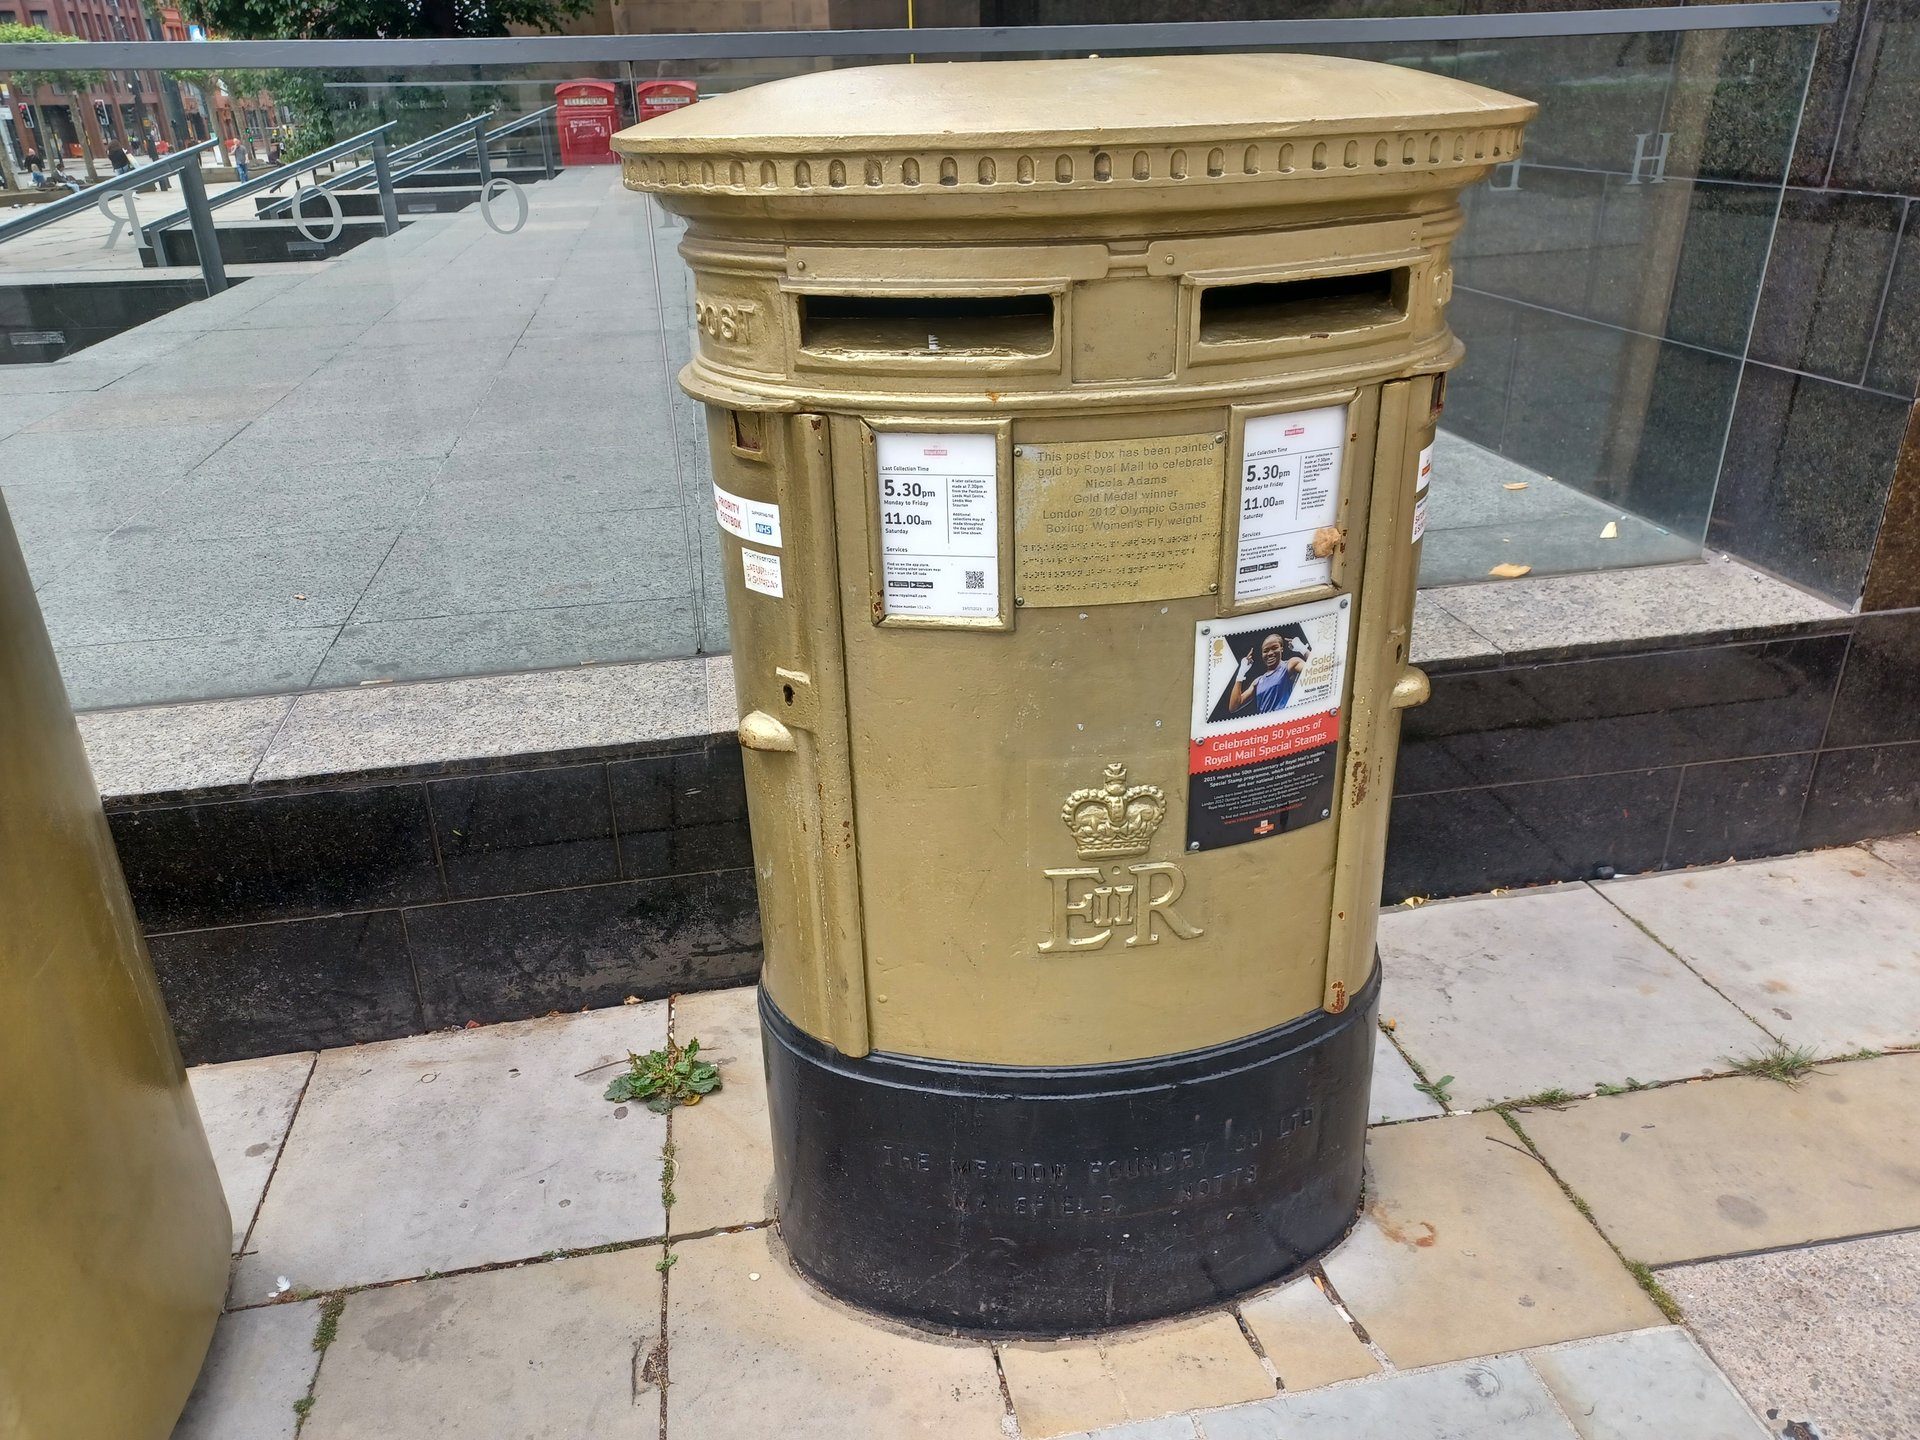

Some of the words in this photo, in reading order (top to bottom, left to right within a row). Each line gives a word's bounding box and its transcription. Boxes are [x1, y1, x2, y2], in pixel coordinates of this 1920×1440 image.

[348, 100, 449, 109] HENRY
[1037, 451, 1062, 461] This
[1066, 450, 1090, 463] post
[1094, 450, 1115, 459] box
[1120, 448, 1139, 458] has
[1143, 447, 1170, 456] been
[1174, 441, 1215, 455] painted
[1038, 466, 1062, 479] gold
[1066, 466, 1080, 477] by
[1084, 463, 1116, 476] Royal
[1120, 461, 1144, 472] Mail
[1148, 461, 1158, 470] to
[1162, 457, 1213, 469] celebrate
[1246, 464, 1290, 482] 5.30pm
[884, 479, 936, 498] 5.30pm
[1085, 478, 1123, 488] Nicola
[1127, 476, 1168, 486] Adams
[1245, 484, 1263, 492] Monday
[1073, 493, 1100, 504] Gold
[1104, 491, 1138, 502] Medal
[1141, 489, 1179, 499] winner
[1244, 496, 1284, 511] 11.00am
[1042, 509, 1084, 520] London
[1088, 506, 1116, 518] 2012
[1120, 504, 1165, 516] Olympic
[1168, 501, 1207, 512] Games
[1243, 512, 1264, 520] Saturday
[884, 512, 932, 526] 11.00am
[1046, 523, 1088, 534] Boxing:
[1092, 519, 1143, 531] Women's
[1147, 517, 1164, 528] Fly
[1167, 514, 1202, 526] weight
[756, 523, 772, 534] NHS
[1242, 531, 1261, 539] Services
[1311, 654, 1332, 666] Gold
[1305, 663, 1332, 676] Medal
[1299, 672, 1330, 687] Winner
[1212, 735, 1269, 752] Celebrating
[1272, 729, 1284, 740] 50
[1285, 724, 1311, 738] years
[1313, 719, 1322, 729] of
[1204, 753, 1232, 766] Royal
[1235, 748, 1256, 761] Mail
[1258, 740, 1292, 756] Special
[1294, 732, 1327, 747] Stamps
[1253, 763, 1281, 774] anniversary
[1285, 758, 1297, 766] Royal
[1227, 776, 1243, 784] Stamp
